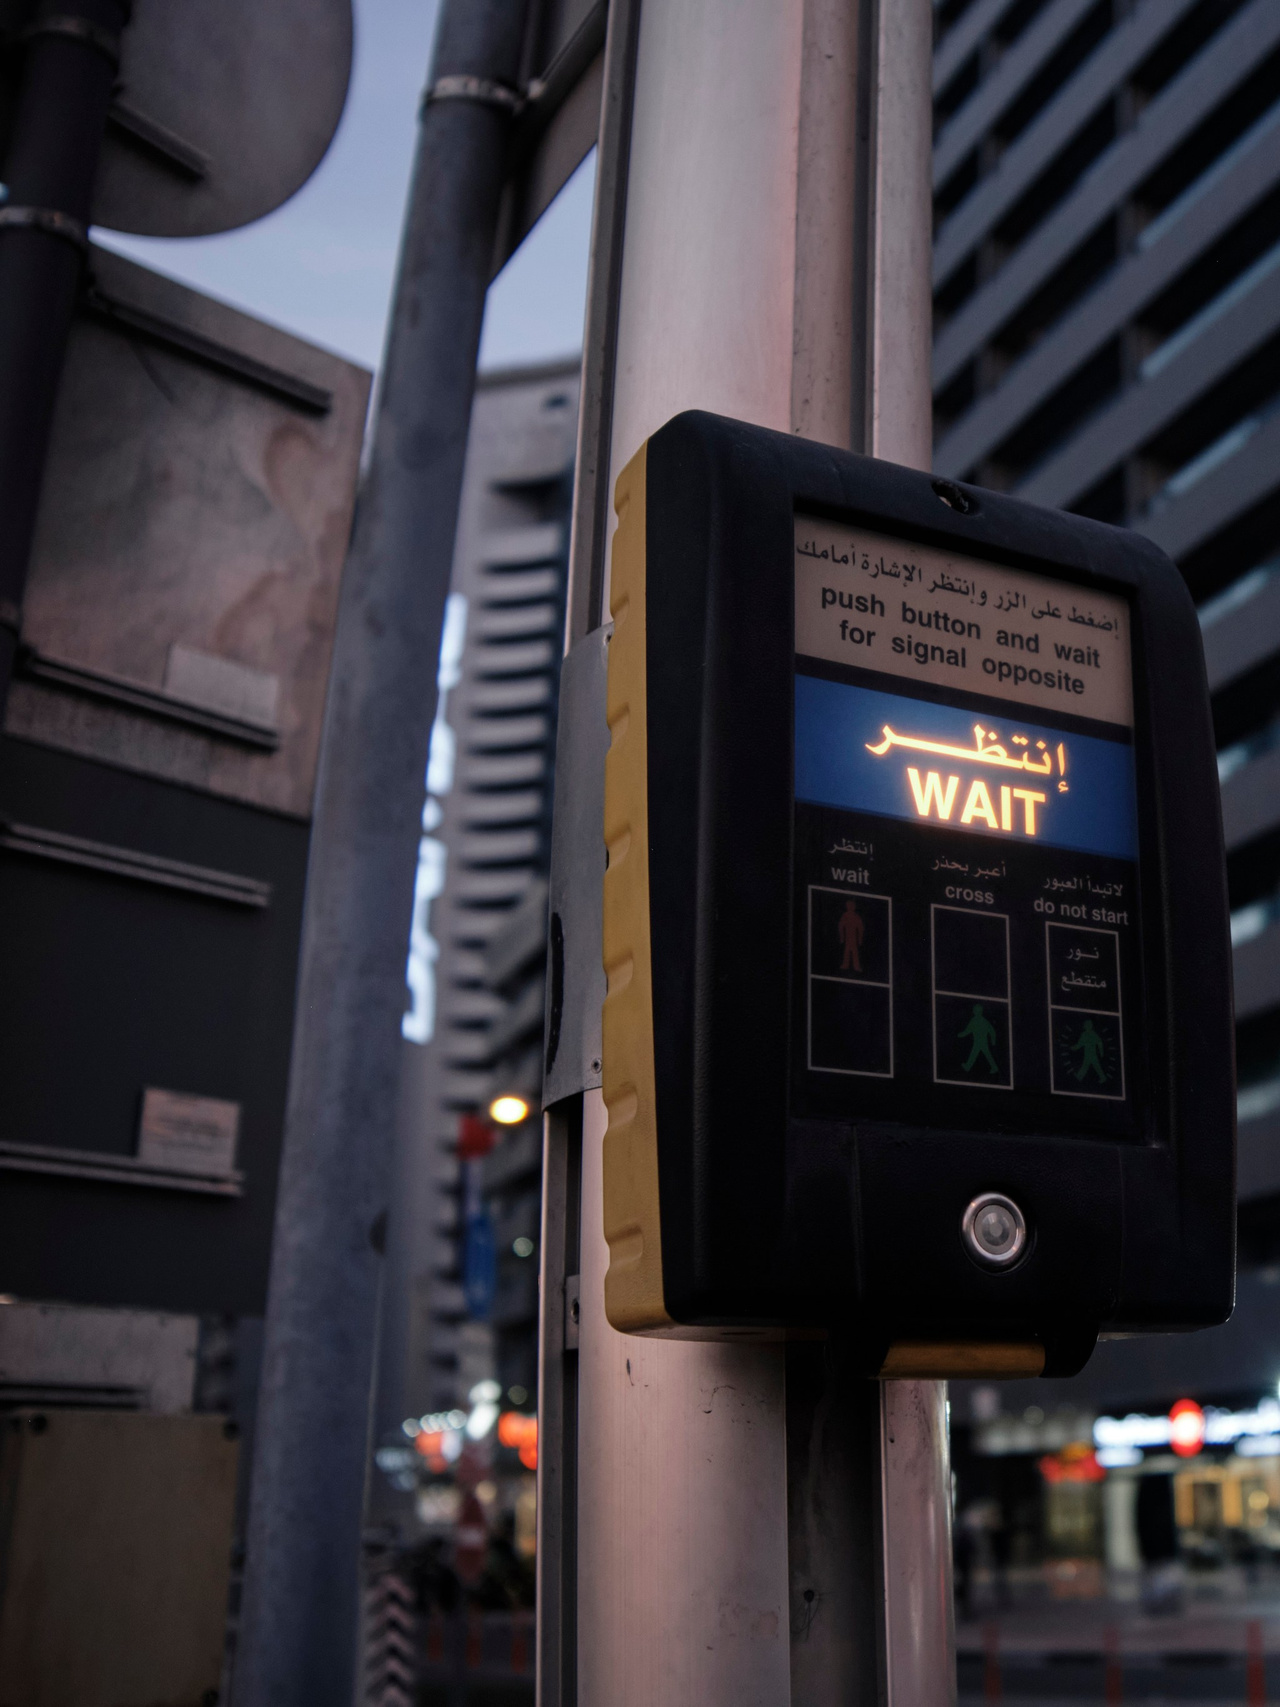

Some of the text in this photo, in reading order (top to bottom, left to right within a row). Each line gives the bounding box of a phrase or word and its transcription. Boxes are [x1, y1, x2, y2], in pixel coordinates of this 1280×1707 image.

[796, 541, 856, 566] أمامك
[993, 591, 1026, 612] الزر
[1031, 600, 1062, 620] على
[821, 586, 1100, 669] push button and wait
[840, 619, 1086, 695] for signal opposite
[907, 767, 1046, 836] WAIT
[831, 867, 870, 885] wait
[945, 885, 994, 905] cross
[1033, 897, 1129, 926] do not start
[1061, 971, 1107, 992] متقطع
